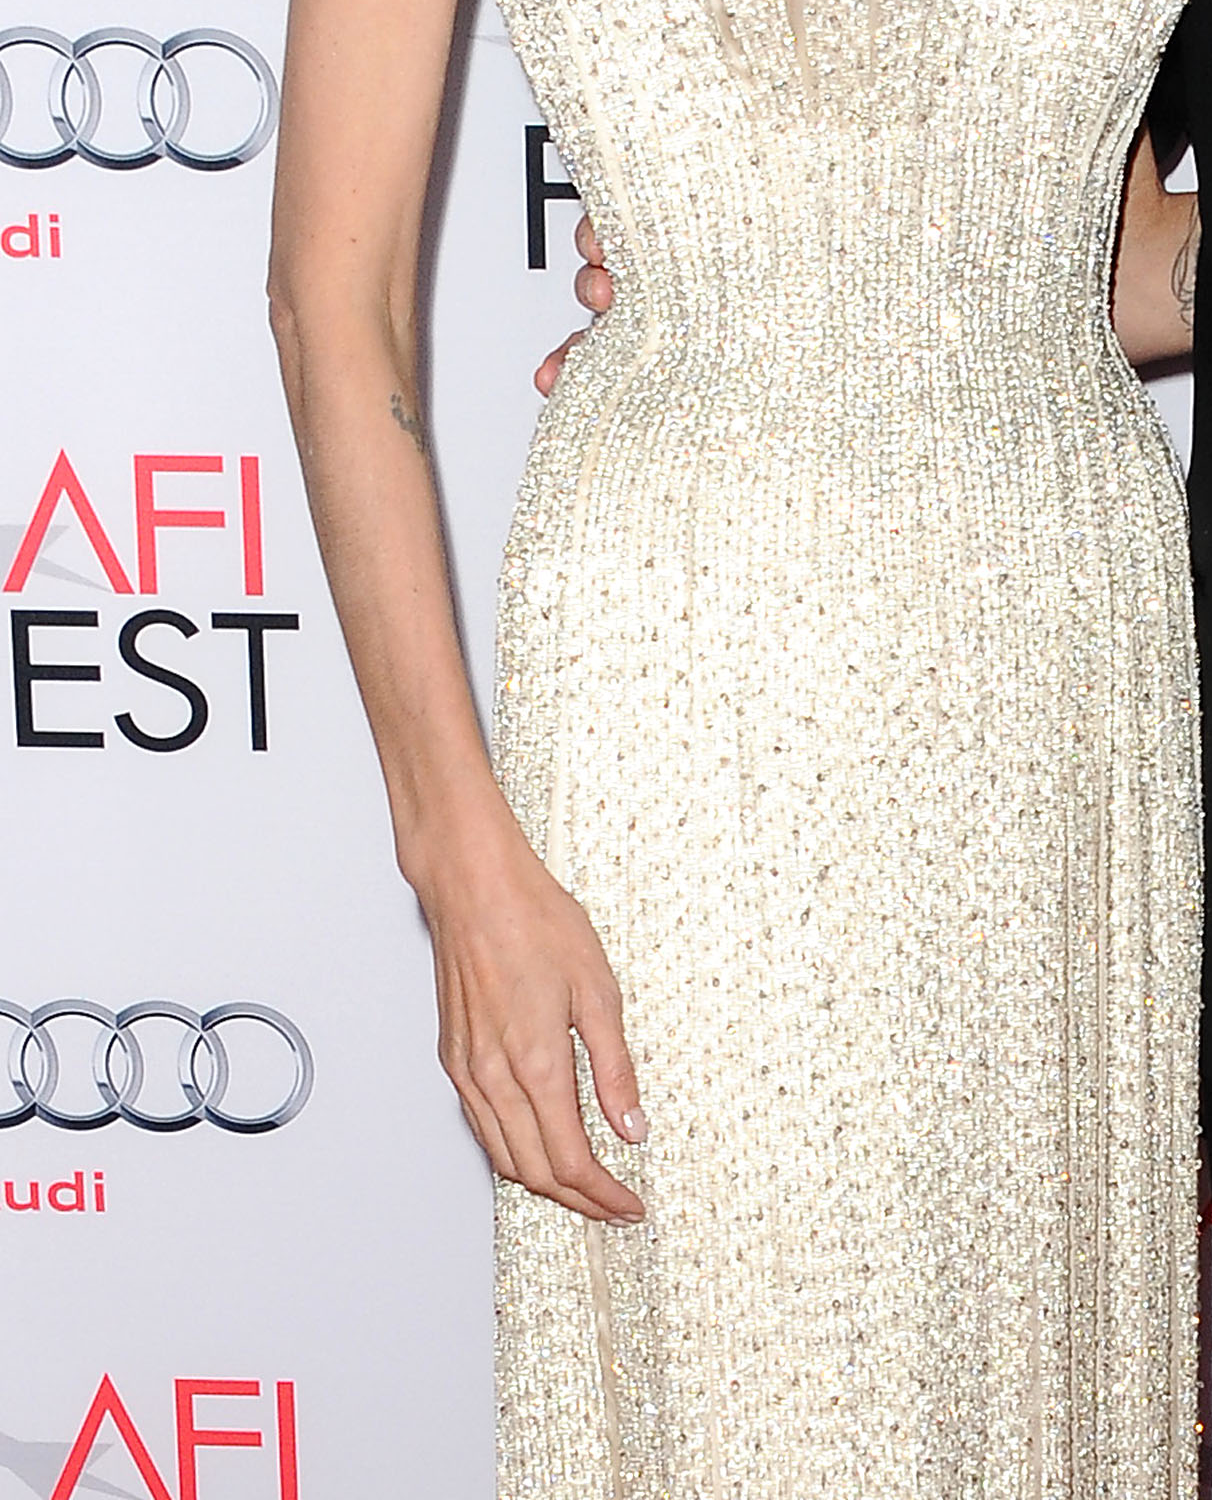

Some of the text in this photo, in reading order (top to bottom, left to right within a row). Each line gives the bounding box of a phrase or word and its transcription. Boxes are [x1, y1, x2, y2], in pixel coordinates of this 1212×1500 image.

[2, 448, 264, 597] AFI
[10, 609, 300, 753] EST
[3, 1170, 106, 1213] udi
[50, 1372, 299, 1500] AFI
